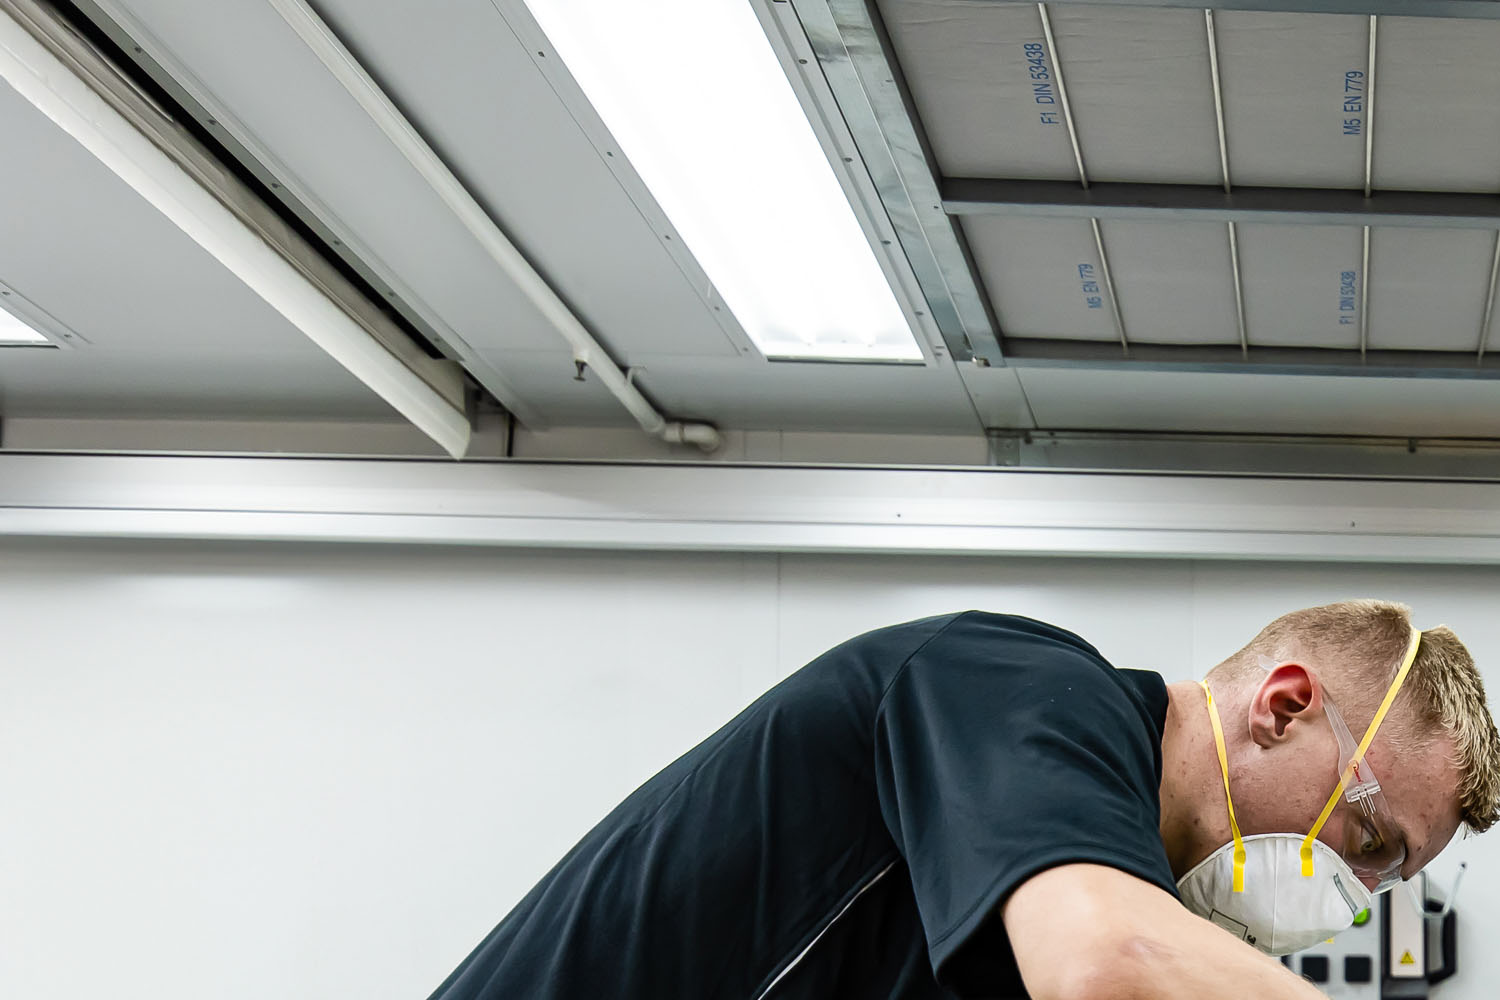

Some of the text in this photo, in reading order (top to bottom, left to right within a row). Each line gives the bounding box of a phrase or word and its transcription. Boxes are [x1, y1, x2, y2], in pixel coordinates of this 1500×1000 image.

[1023, 42, 1060, 125] F1 DIN 53438
[1343, 70, 1364, 135] M5 EN 779
[1077, 263, 1096, 280] 779
[1081, 280, 1099, 293] EN
[1339, 296, 1356, 311] DIN
